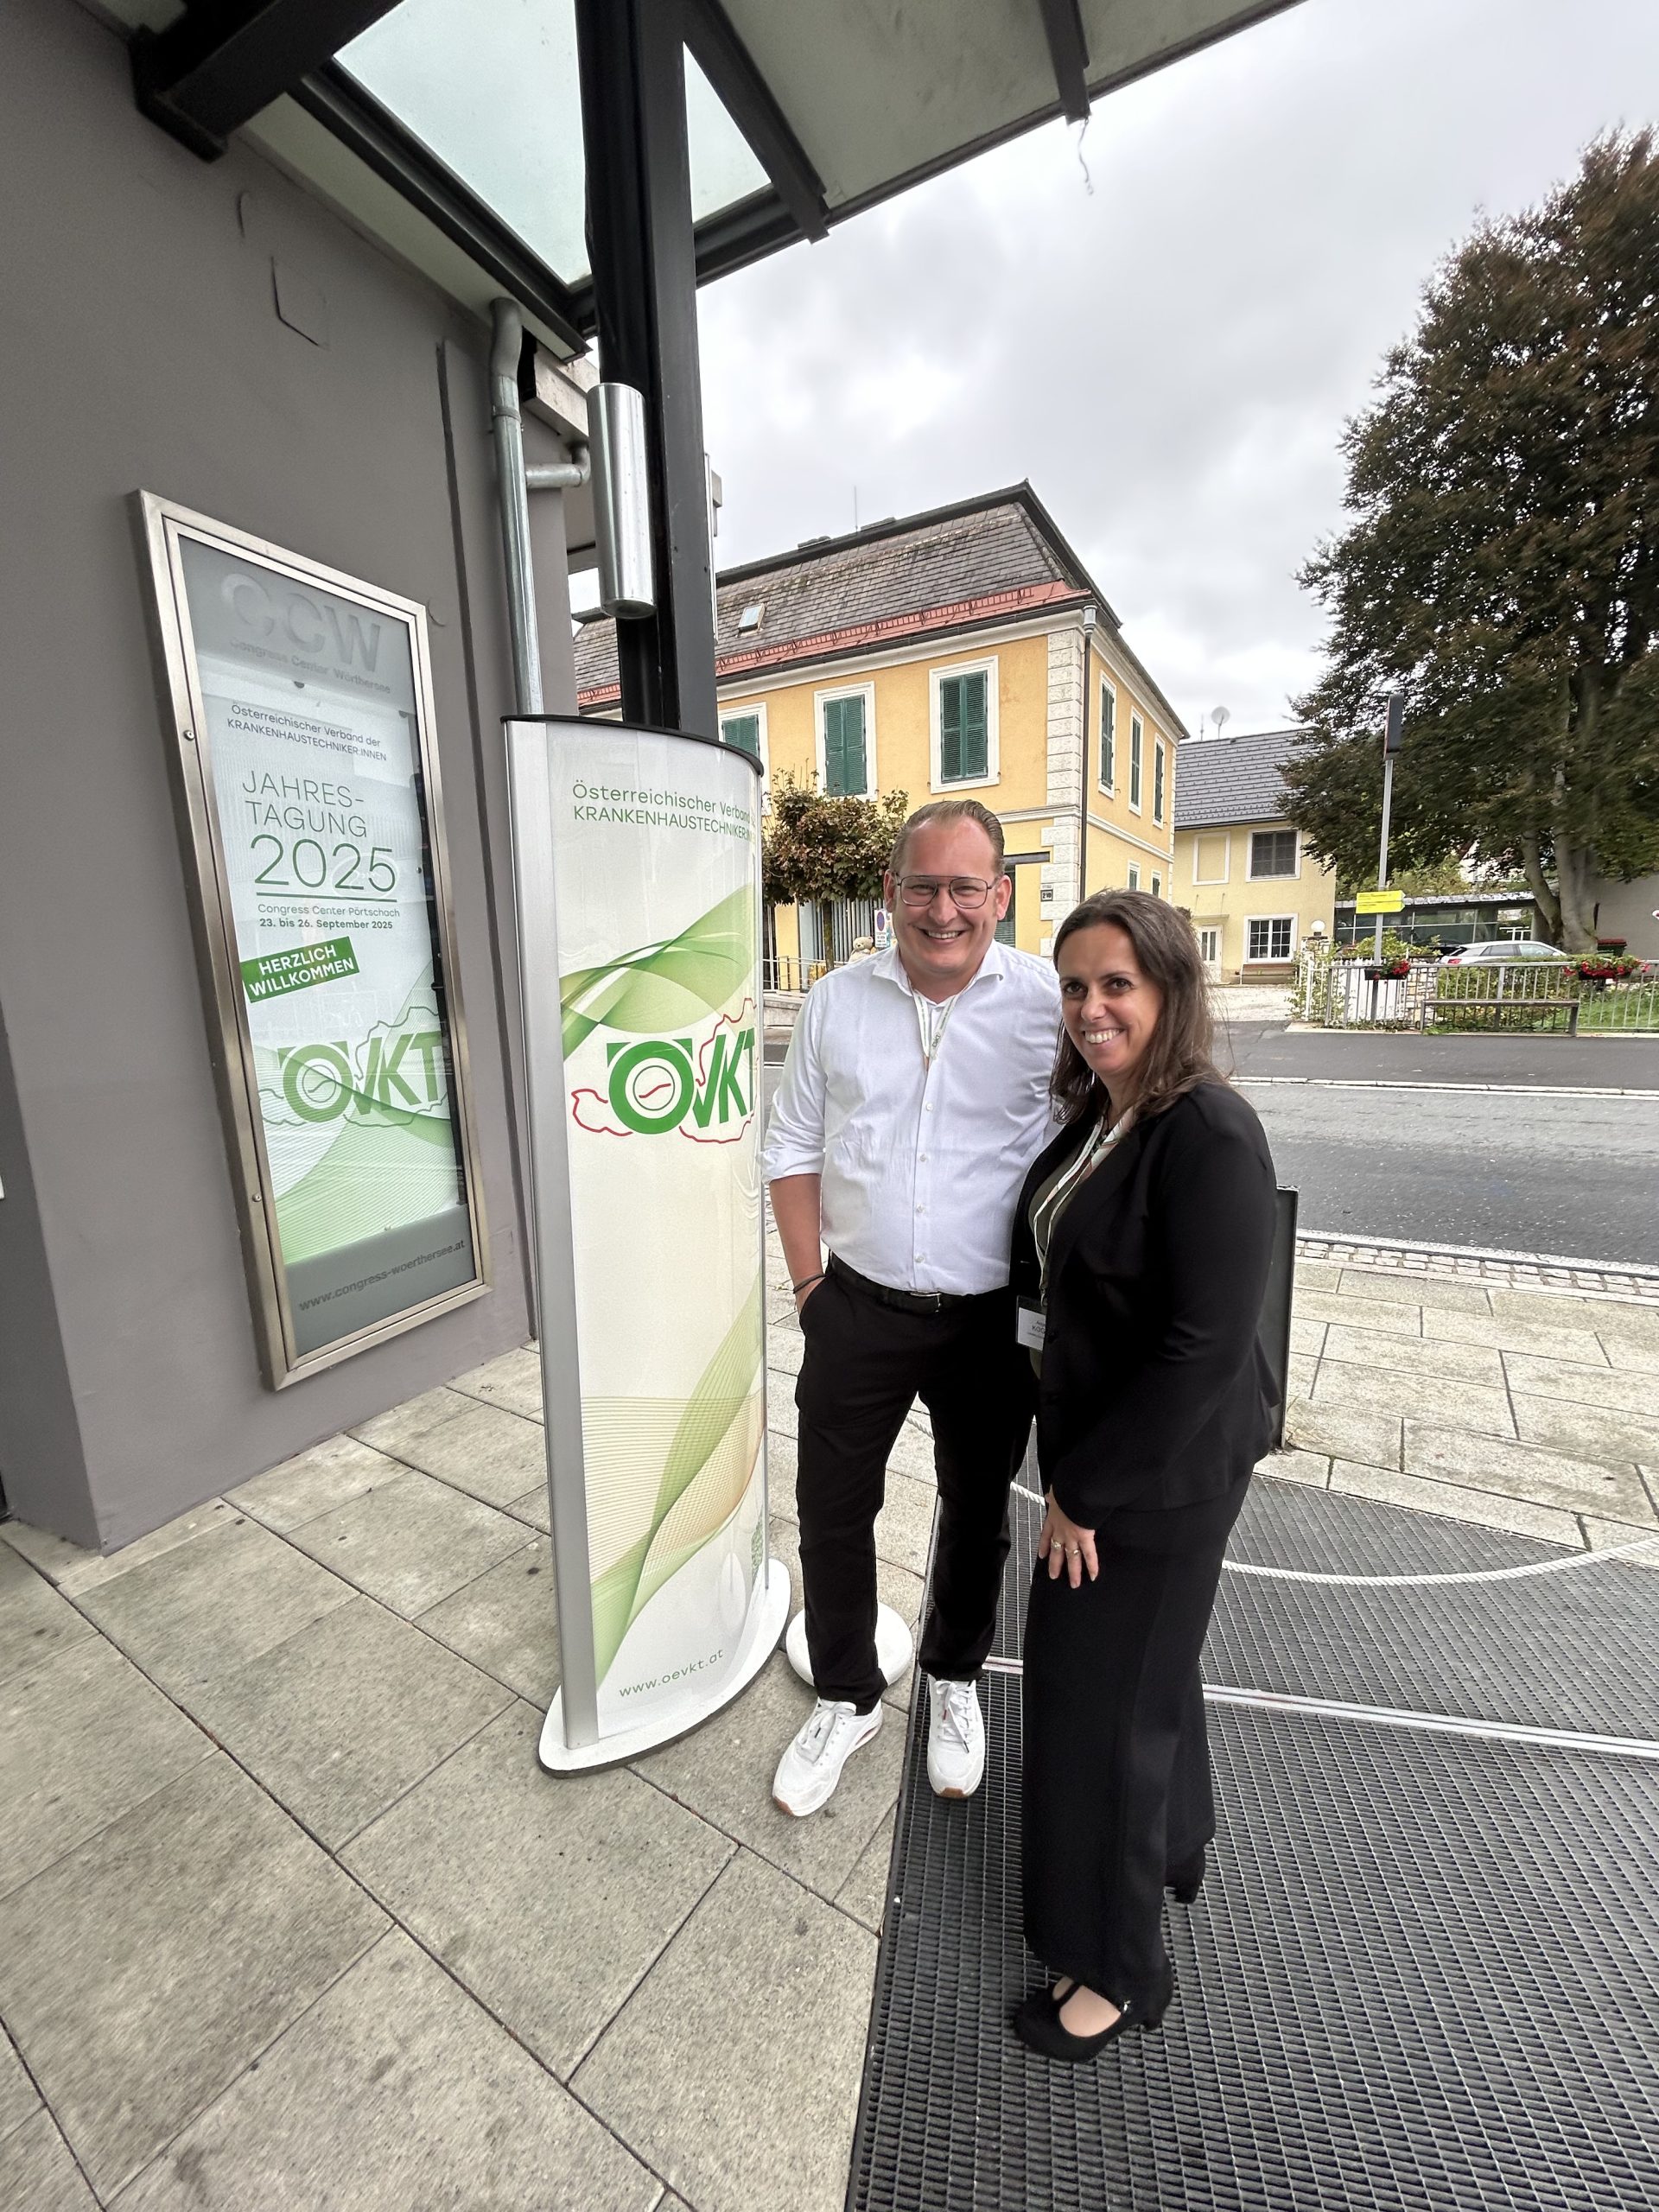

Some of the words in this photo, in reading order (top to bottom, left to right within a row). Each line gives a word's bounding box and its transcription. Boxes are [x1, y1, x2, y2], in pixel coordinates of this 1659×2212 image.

[291, 655, 328, 675] Center
[226, 718, 387, 761] KRANKENHAUSTECHNIKER:INNEN
[324, 726, 364, 744] Verband
[365, 735, 381, 747] der
[242, 771, 365, 807] JAHRES-
[572, 779, 716, 813] Österreichischer
[245, 800, 367, 837] TAGUNG
[251, 834, 396, 892] 2025
[257, 904, 309, 916] Congress
[312, 906, 346, 915] Center
[348, 906, 400, 917] Pörtschach
[259, 918, 276, 927] 23.
[279, 918, 295, 927] bis
[298, 918, 313, 928] 26.
[316, 919, 369, 930] September
[372, 920, 393, 929] 2025
[249, 957, 354, 996] WILLKOMMEN
[258, 944, 337, 976] HERZLICH
[299, 1240, 466, 1312] www.congress-woerthersee.at
[619, 1649, 723, 1697] www.oevkt.at
